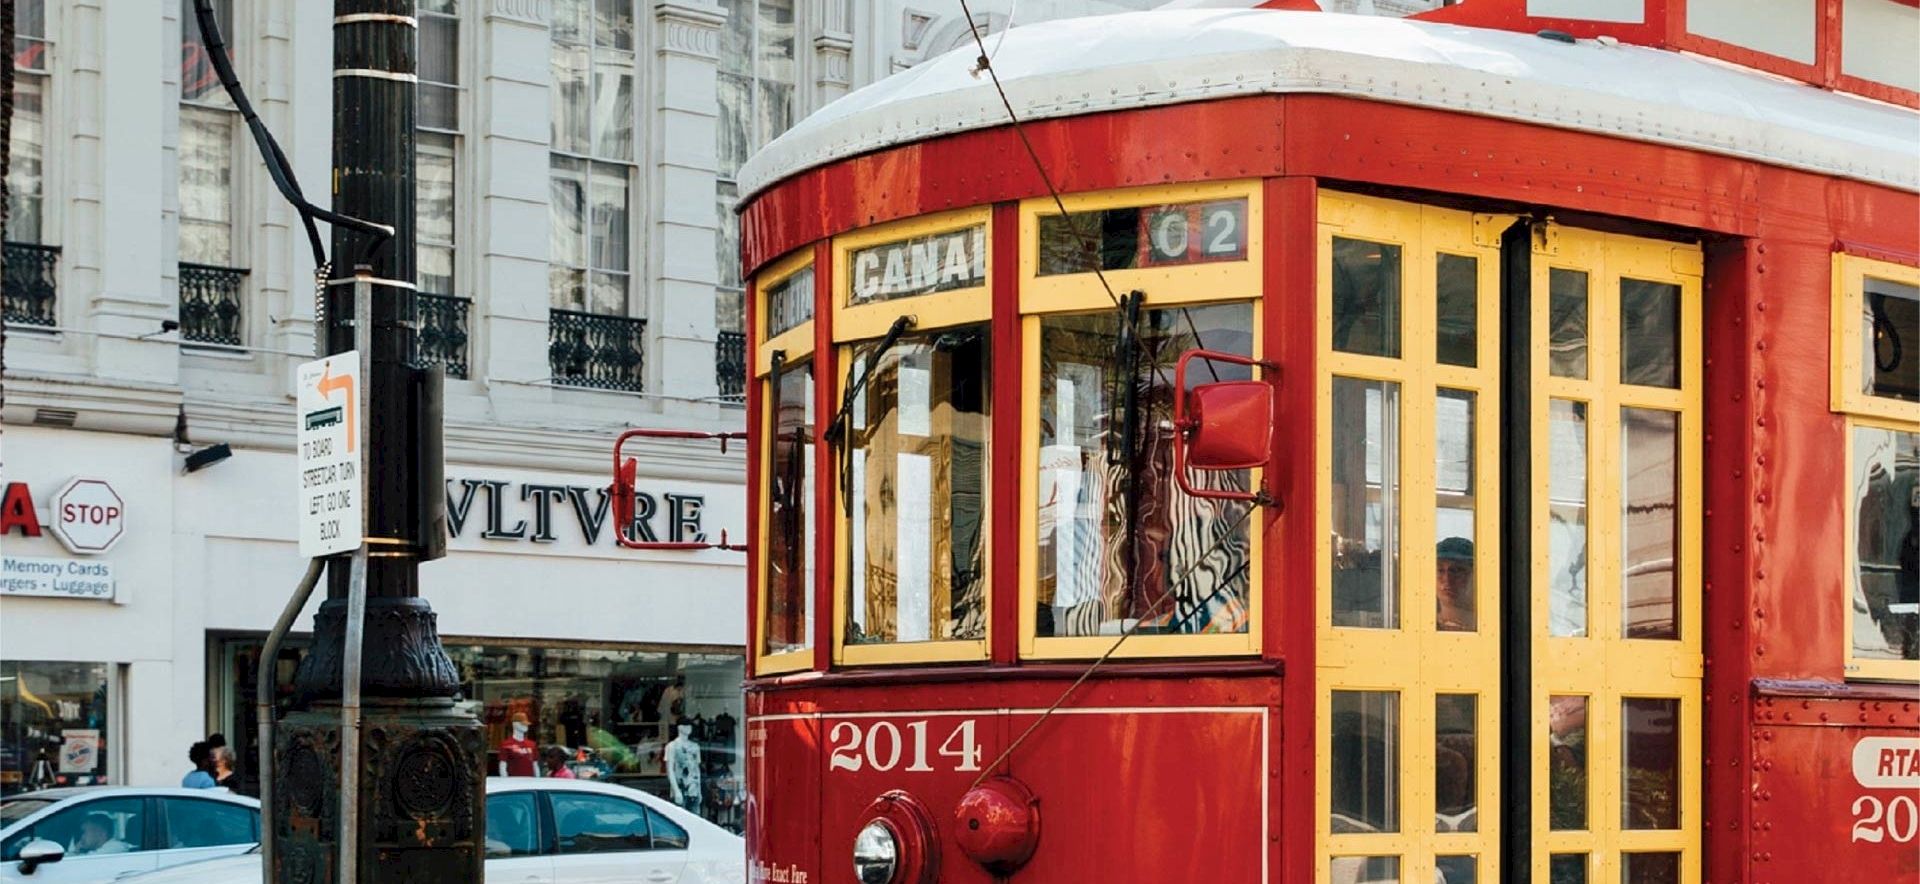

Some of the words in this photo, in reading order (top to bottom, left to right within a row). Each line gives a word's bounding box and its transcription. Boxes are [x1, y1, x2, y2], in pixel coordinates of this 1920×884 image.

[304, 442, 311, 460] TO
[313, 437, 332, 457] BOARD
[340, 461, 355, 480] TURN
[327, 492, 336, 511] GO
[338, 489, 351, 509] ONE
[63, 503, 119, 525] STOP
[320, 520, 340, 540] BLOCK
[3, 560, 63, 578] Memory
[67, 562, 109, 576] Cards
[53, 578, 109, 595] Luggage
[829, 719, 982, 772] 2014
